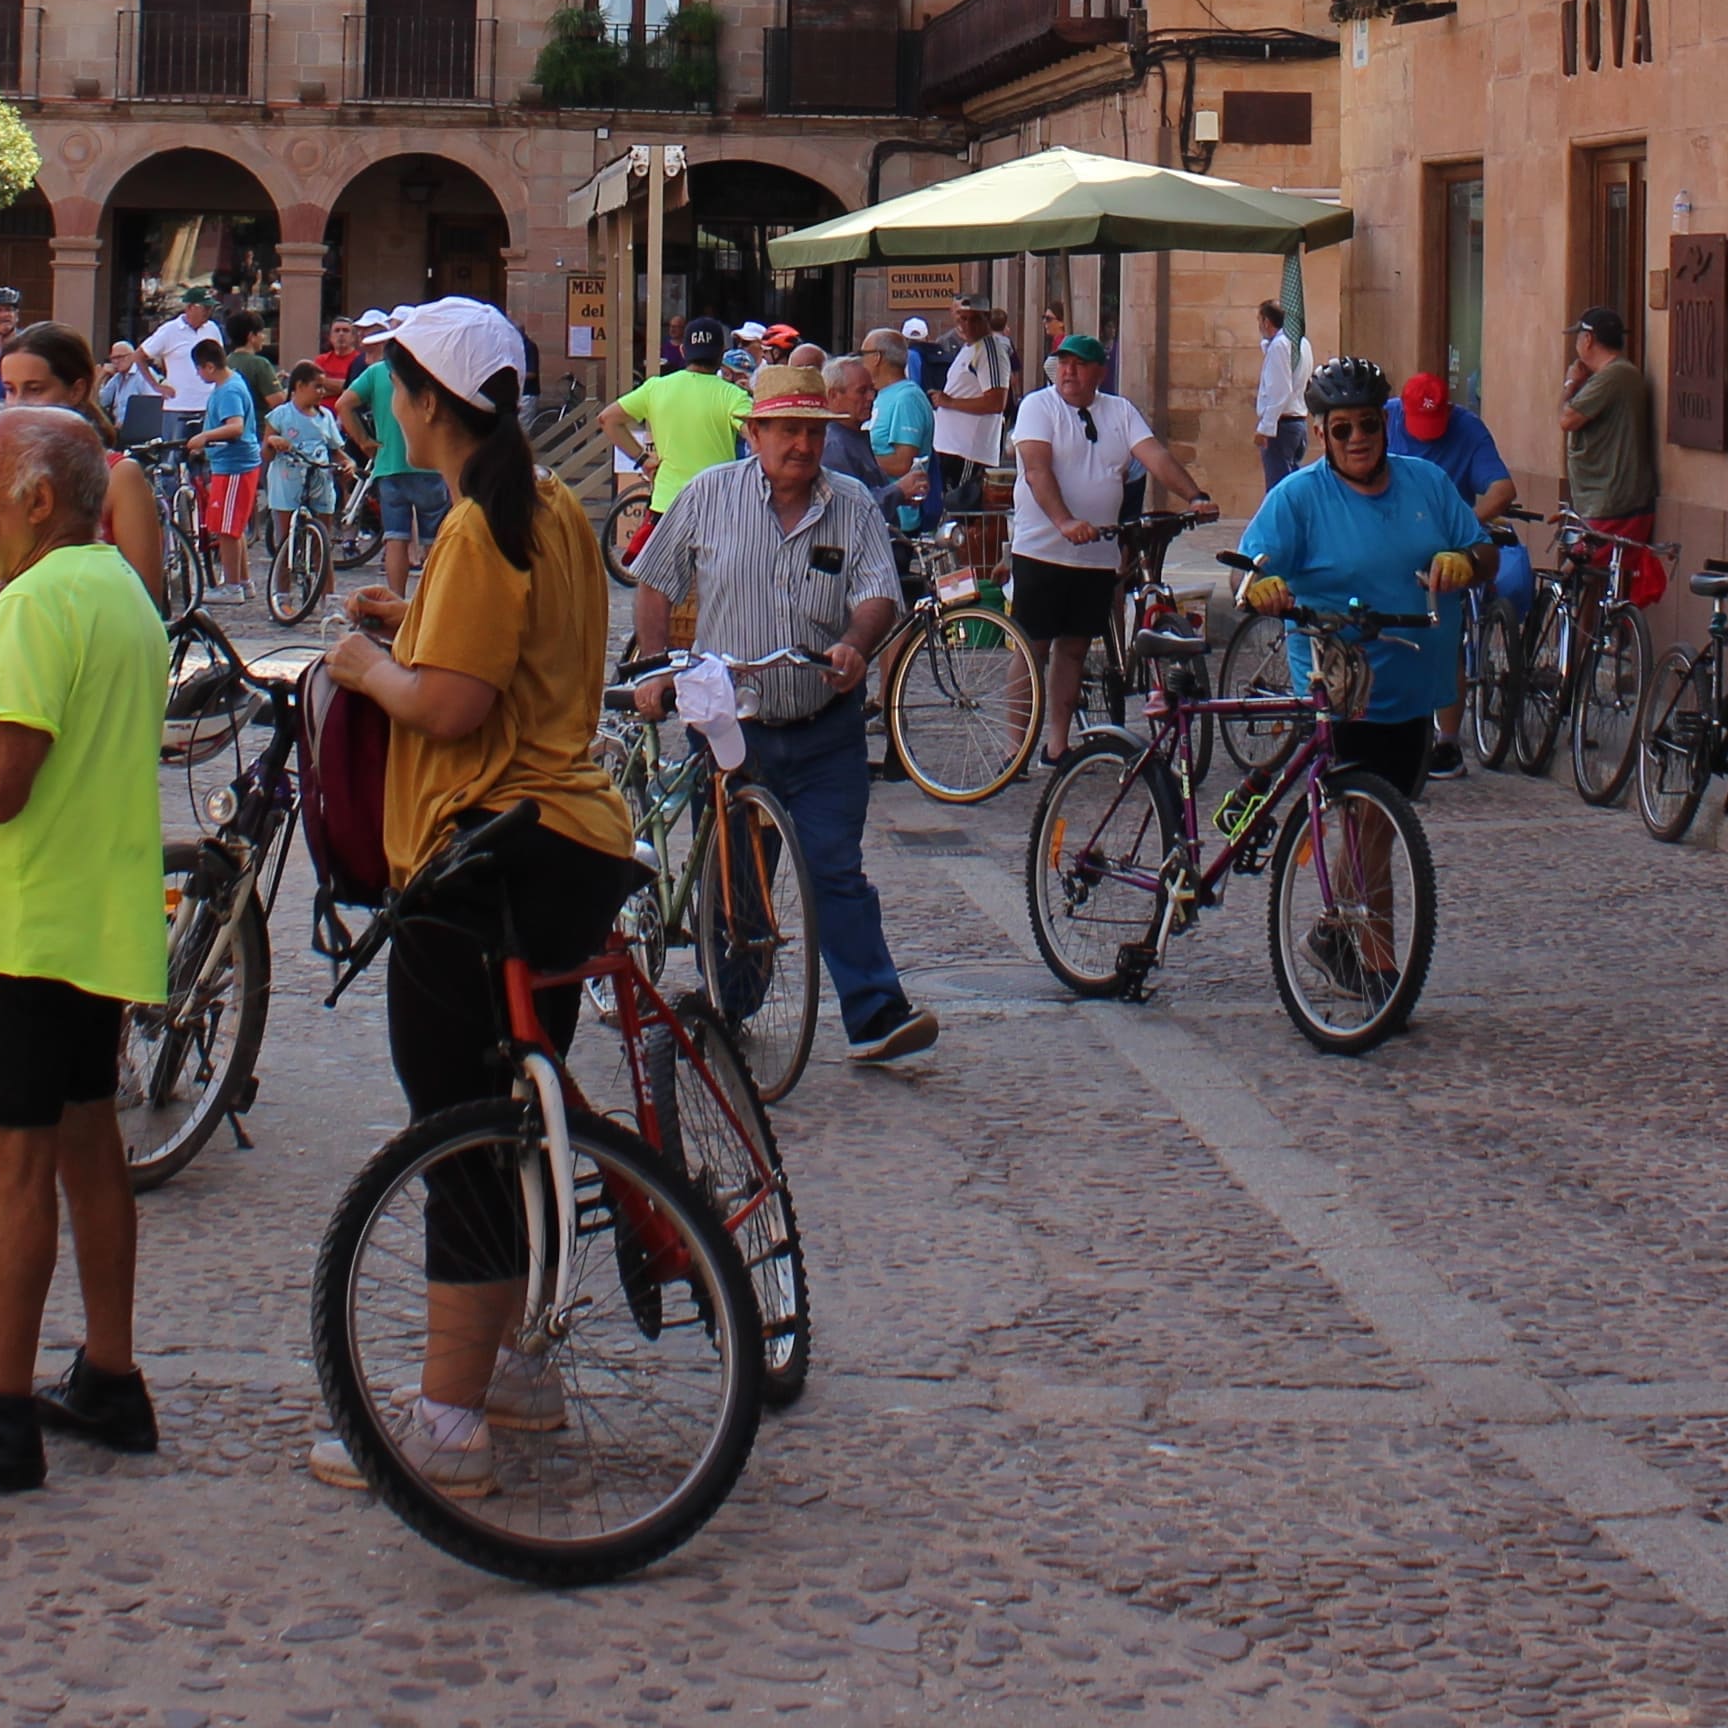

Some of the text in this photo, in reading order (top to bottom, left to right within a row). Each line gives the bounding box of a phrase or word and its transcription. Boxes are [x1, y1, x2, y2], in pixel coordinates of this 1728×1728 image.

[891, 272, 954, 284] CHURRERIA
[572, 280, 605, 295] MEN
[891, 288, 954, 299] DESAYUNOS
[580, 303, 605, 318] del
[690, 330, 714, 345] GAP
